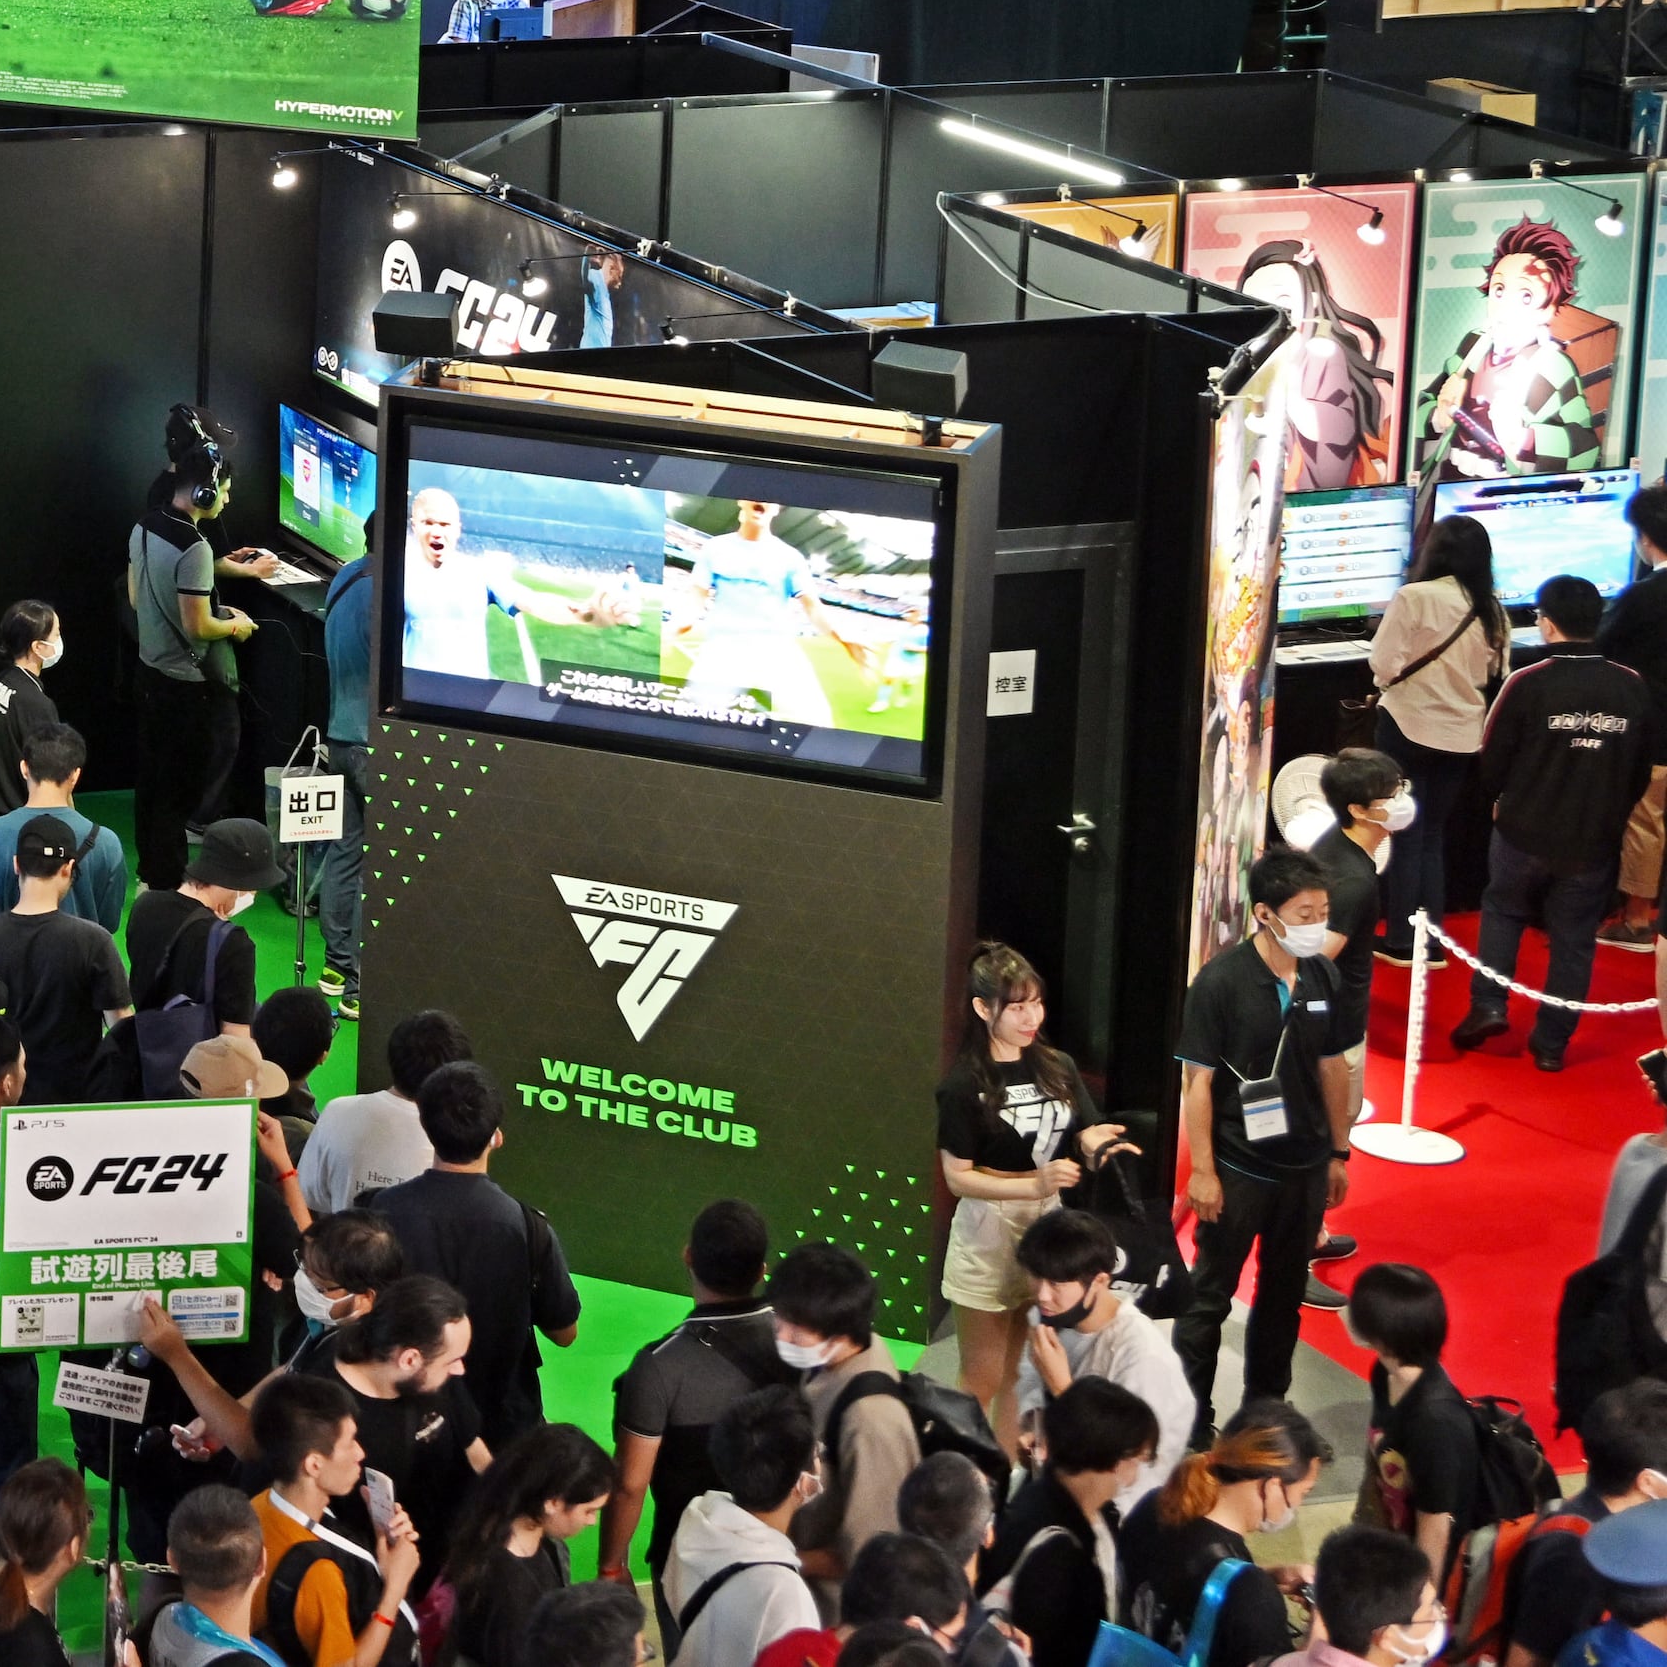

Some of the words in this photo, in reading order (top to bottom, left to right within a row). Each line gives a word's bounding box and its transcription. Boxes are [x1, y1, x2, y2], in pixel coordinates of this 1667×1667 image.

[994, 675, 1028, 694] 控室
[1570, 738, 1604, 749] STAFF
[289, 790, 336, 814] 出口
[301, 815, 324, 825] EXIT
[585, 887, 618, 909] EA
[621, 892, 704, 923] SPORTS
[540, 1057, 735, 1115] WELCOME
[31, 1119, 66, 1128] PS5
[516, 1083, 568, 1112] TO
[574, 1094, 649, 1129] THE
[655, 1110, 758, 1148] CLUB
[35, 1166, 61, 1182] EA
[368, 1170, 393, 1186] Here
[33, 1181, 67, 1191] SPORTS
[30, 1249, 218, 1285] 試遊列最後尾
